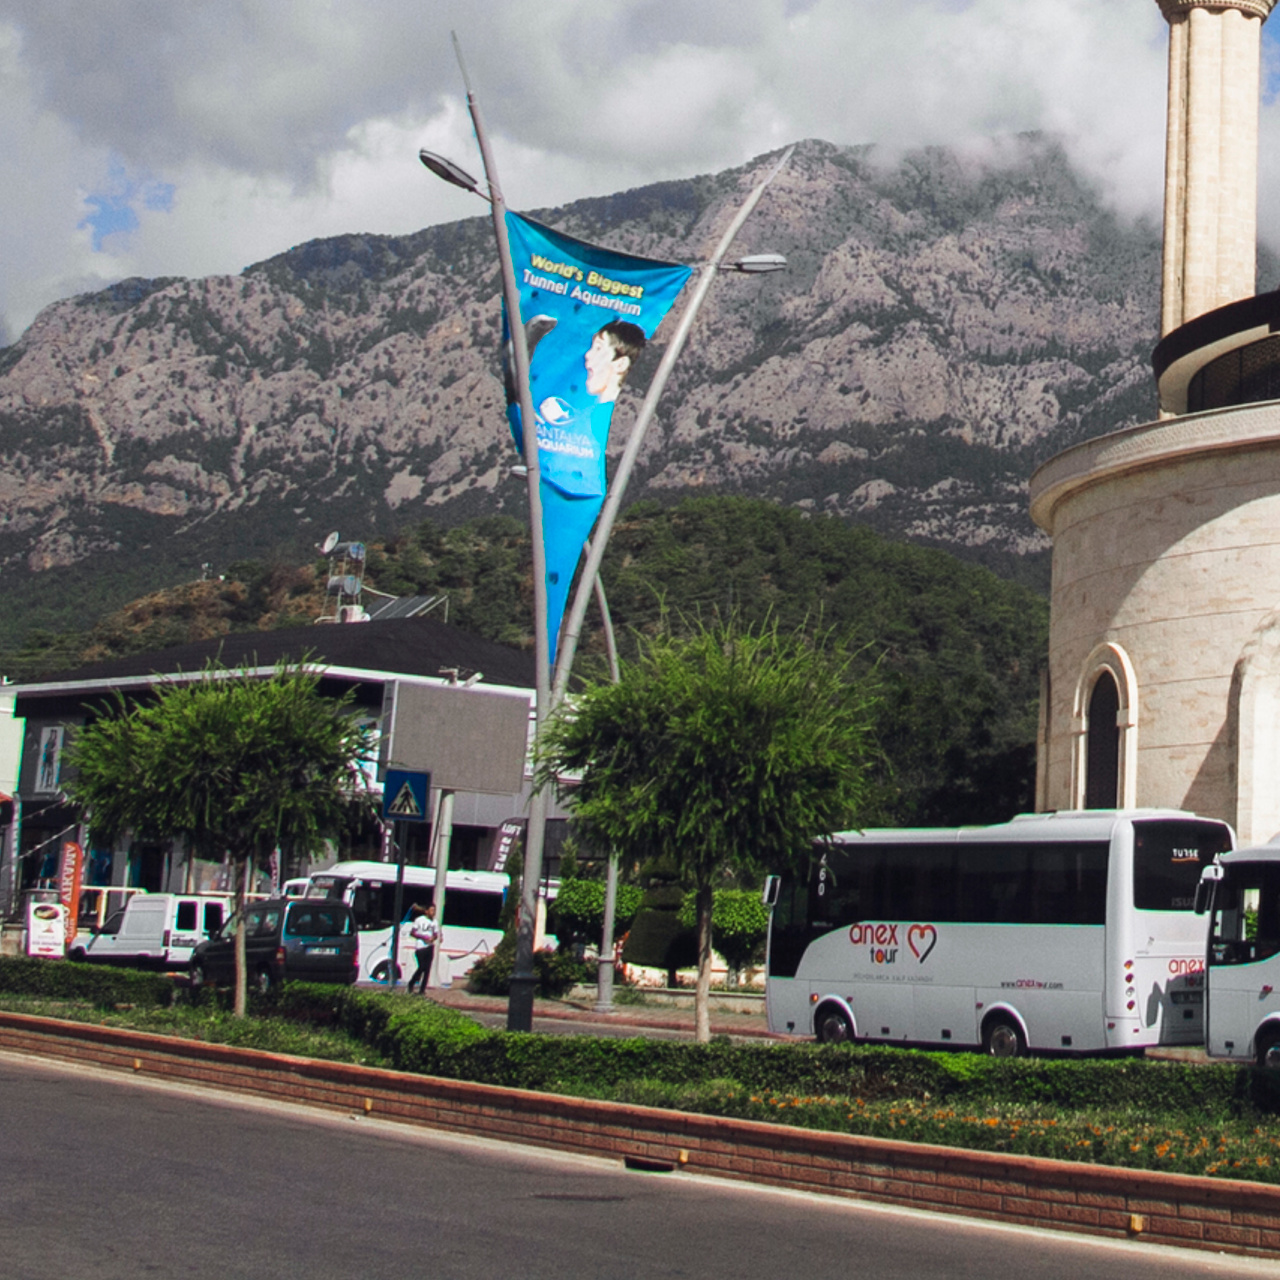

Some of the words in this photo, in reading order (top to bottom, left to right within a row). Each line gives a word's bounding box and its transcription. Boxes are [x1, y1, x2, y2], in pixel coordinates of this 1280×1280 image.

[530, 253, 584, 282] World's
[586, 271, 644, 299] Biggest
[523, 269, 569, 296] Tunnel
[570, 285, 642, 317] Aquarium
[536, 424, 591, 446] ANTALYA
[1172, 848, 1199, 857] TURSE
[849, 923, 898, 945] anex
[870, 947, 898, 964] tour
[1168, 959, 1204, 974] anex
